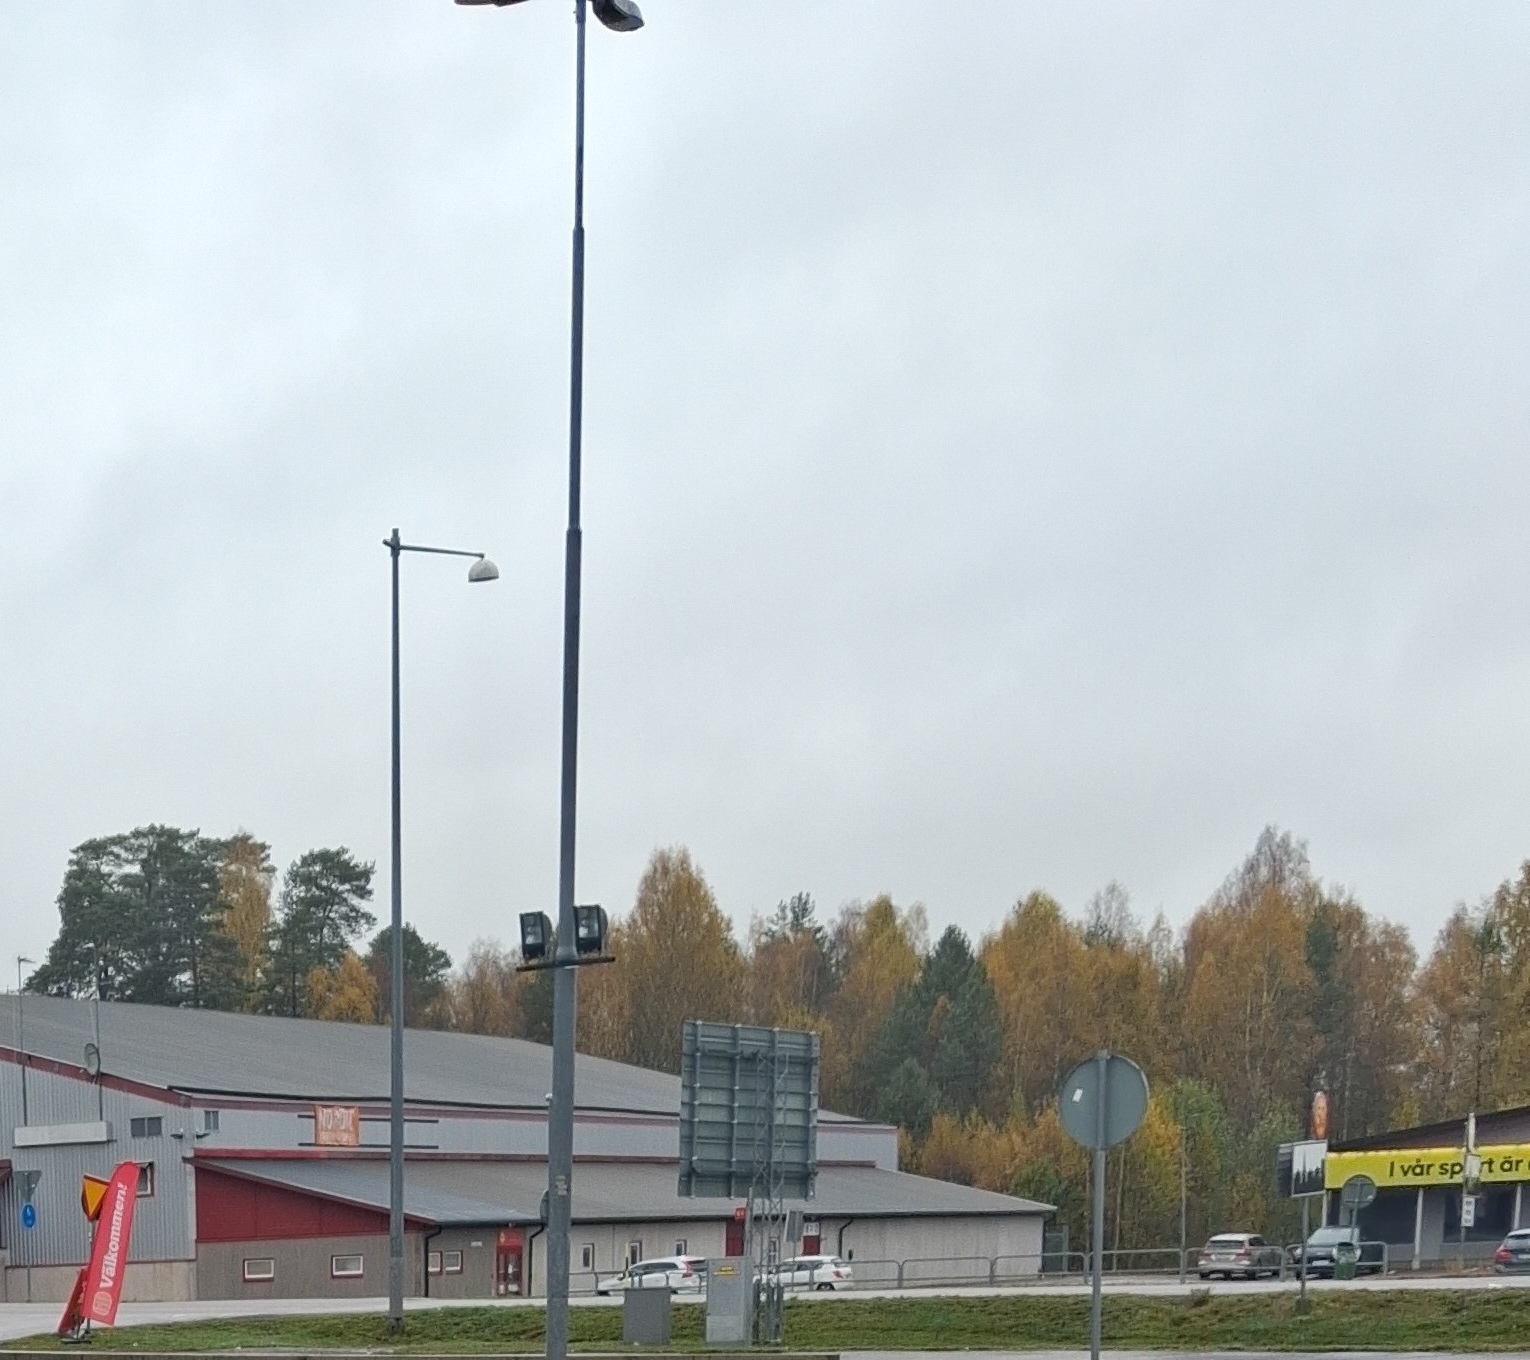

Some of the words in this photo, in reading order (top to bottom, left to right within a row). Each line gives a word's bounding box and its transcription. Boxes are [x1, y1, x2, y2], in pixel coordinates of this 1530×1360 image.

[1389, 1161, 1395, 1177] I
[1400, 1158, 1436, 1177] vår
[1438, 1157, 1495, 1179] sprt
[1499, 1155, 1524, 1173] är
[98, 1181, 128, 1289] Välkommen!
